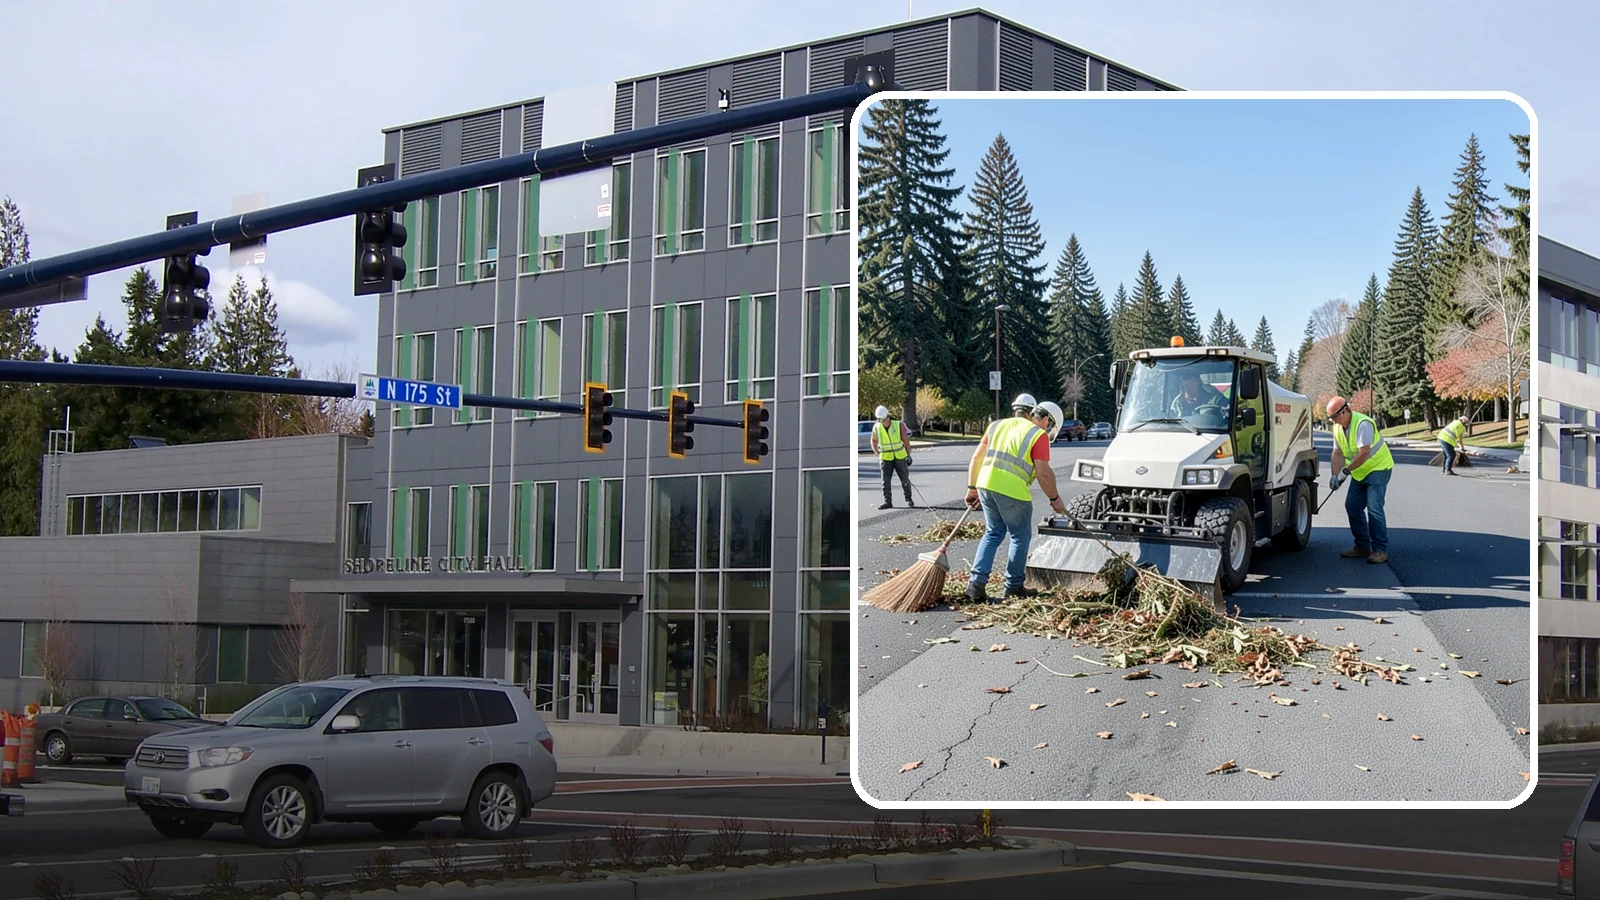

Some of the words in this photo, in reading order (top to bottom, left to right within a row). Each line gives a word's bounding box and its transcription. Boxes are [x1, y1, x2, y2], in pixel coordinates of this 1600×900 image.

[387, 381, 396, 400] N
[405, 382, 428, 403] 175
[436, 386, 452, 406] St
[343, 557, 432, 574] SHORELINE
[438, 556, 476, 572] CITY
[483, 555, 525, 572] HALL
